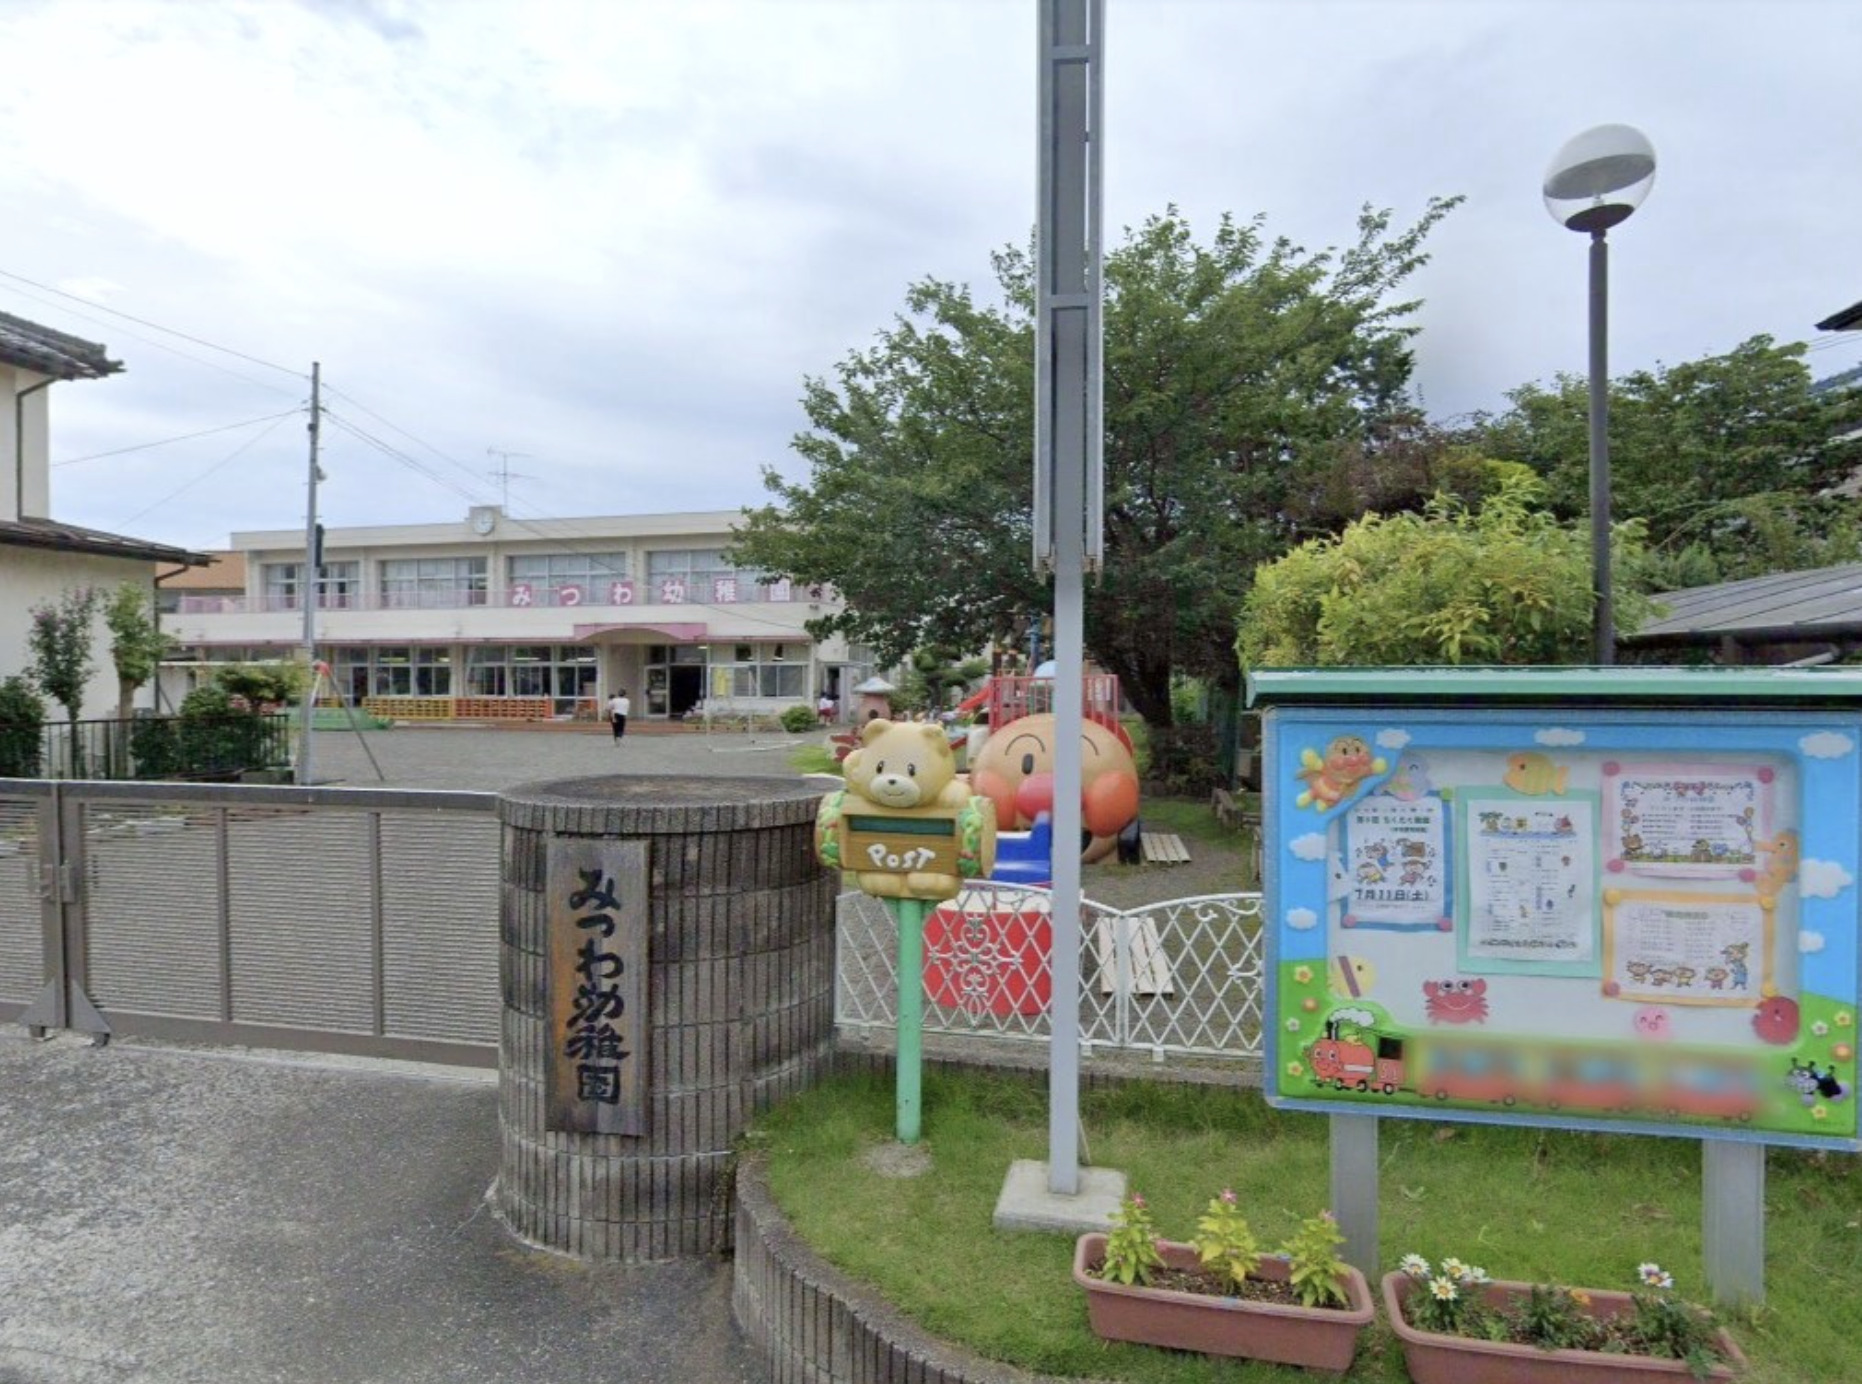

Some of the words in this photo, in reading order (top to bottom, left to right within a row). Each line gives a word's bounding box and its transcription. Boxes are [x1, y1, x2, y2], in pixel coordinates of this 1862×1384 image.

[866, 843, 936, 869] POST
[564, 866, 630, 1105] みつわ幼稚園
